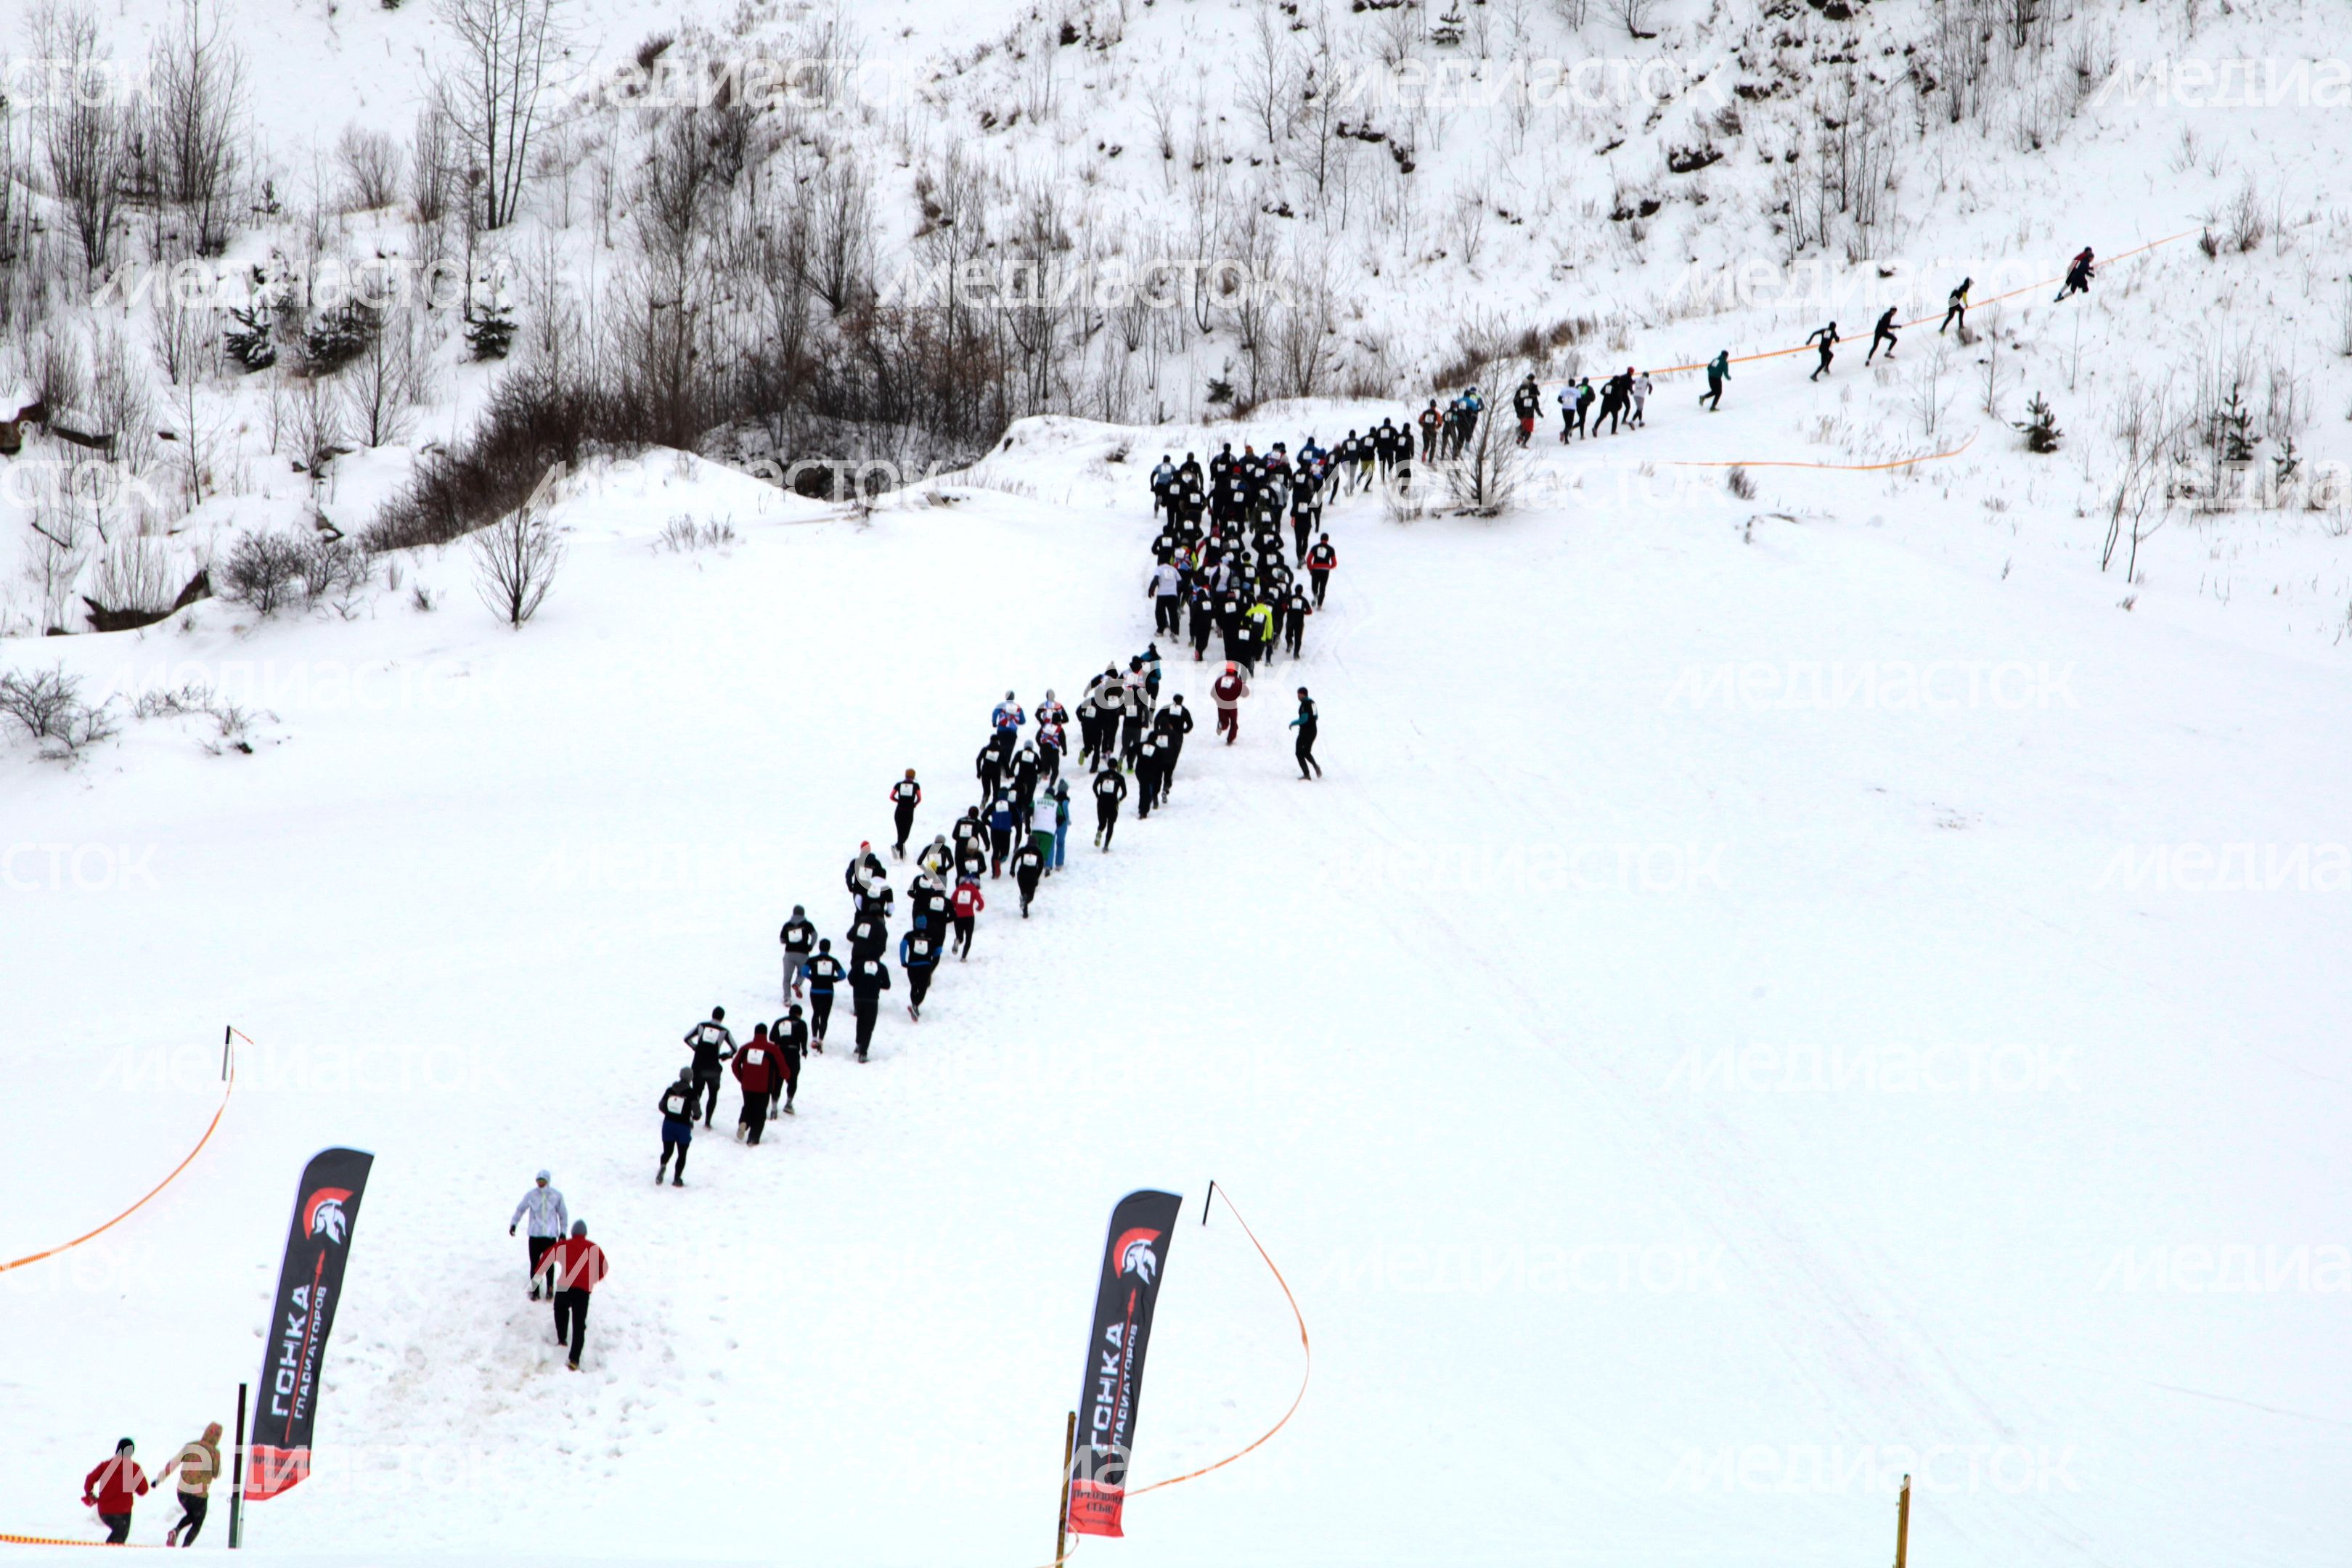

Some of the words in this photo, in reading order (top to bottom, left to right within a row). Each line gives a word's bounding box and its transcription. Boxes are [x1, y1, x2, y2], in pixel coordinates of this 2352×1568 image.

[271, 1284, 311, 1416] ГОНКА
[294, 1286, 327, 1419] ГЛАДИАТОРОВ
[1091, 1322, 1124, 1452] ГОНКА
[1112, 1323, 1138, 1455] ГЛАДИАТОРОВ
